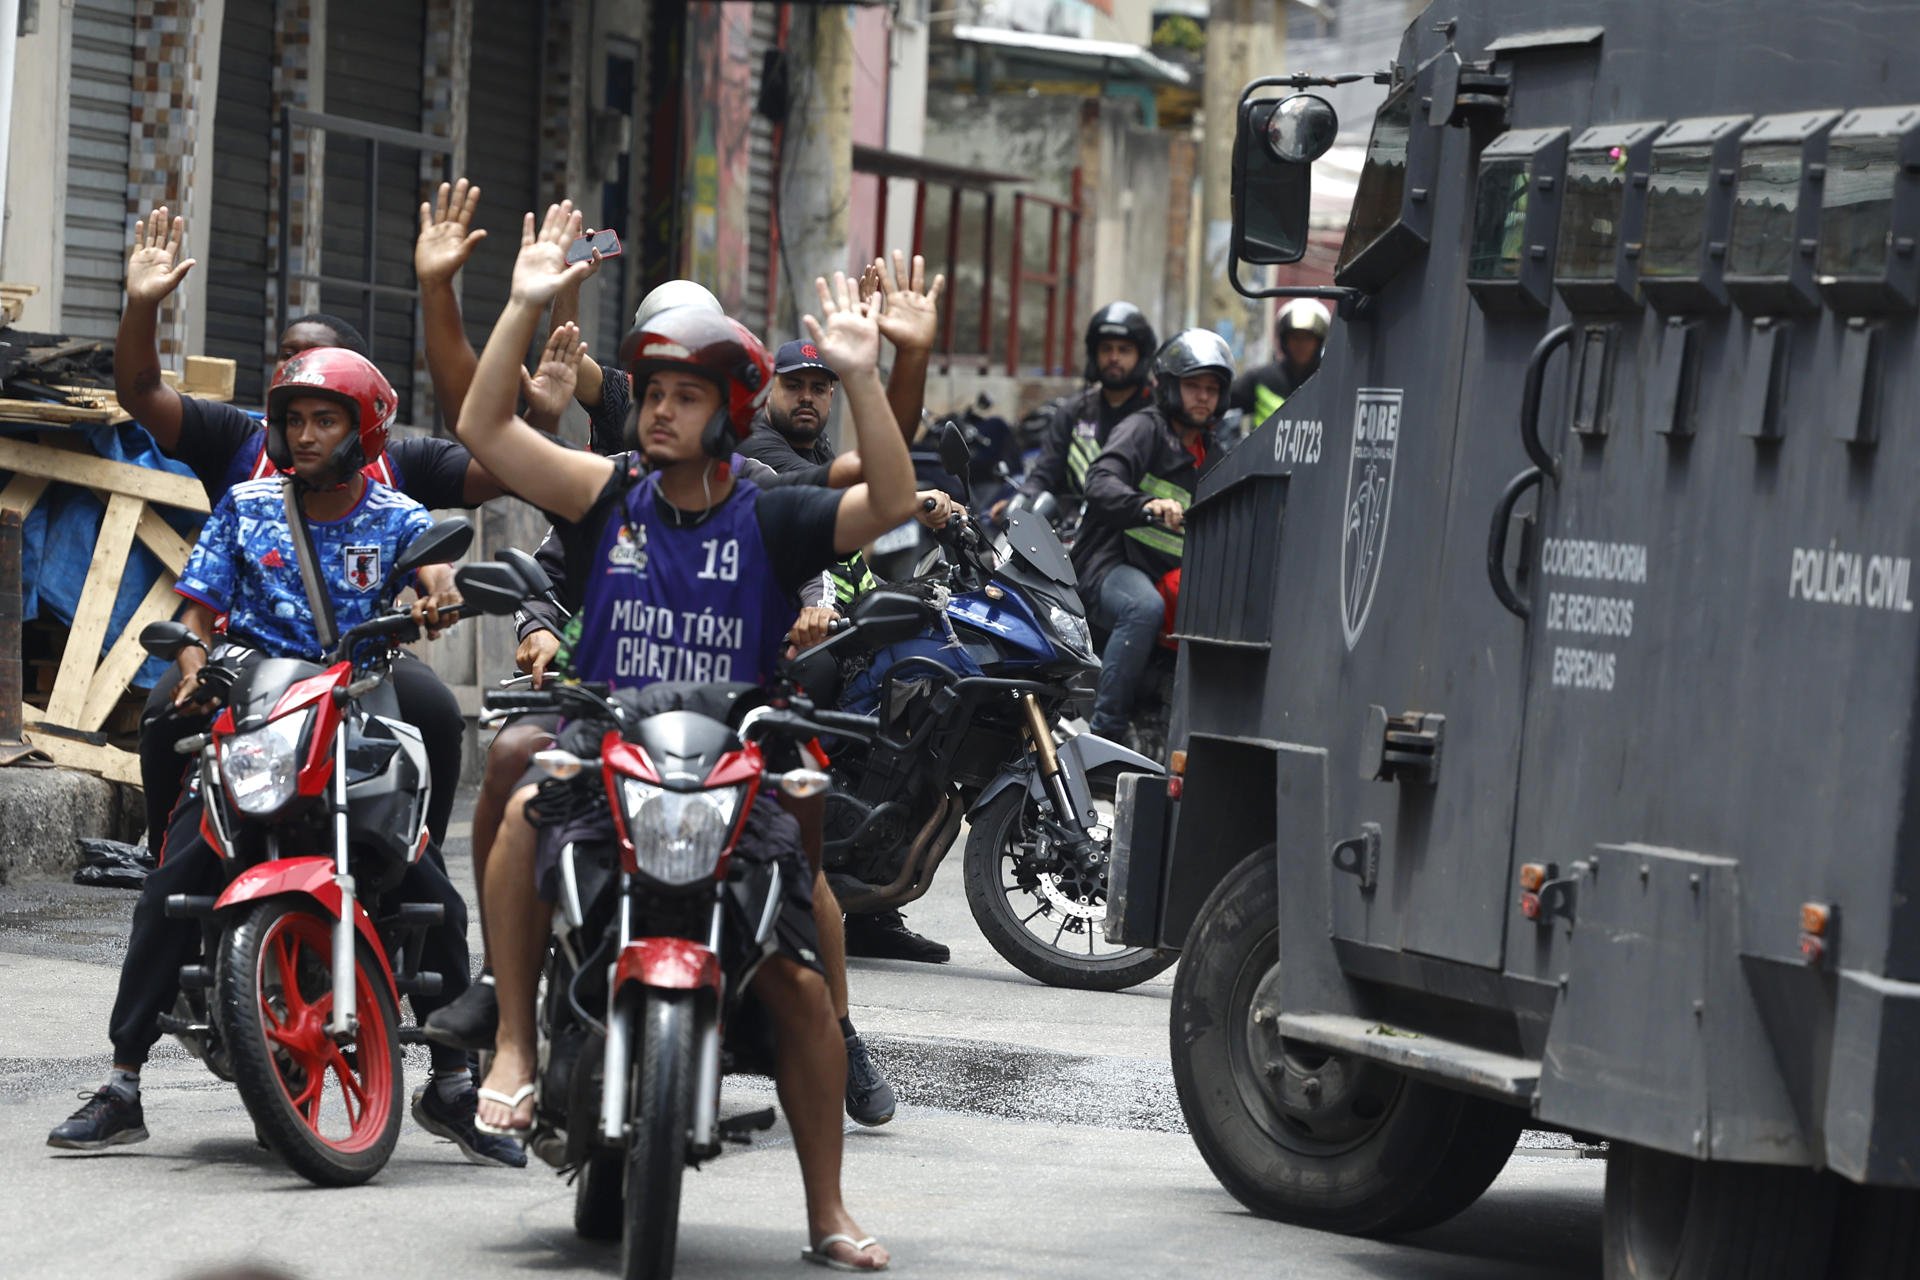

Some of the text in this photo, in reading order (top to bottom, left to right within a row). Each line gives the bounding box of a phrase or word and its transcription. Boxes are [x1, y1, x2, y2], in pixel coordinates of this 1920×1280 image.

[1274, 419, 1323, 464] 67-0723
[1357, 403, 1398, 441] CORE
[698, 538, 739, 581] 19
[1541, 537, 1647, 584] COORDENADORIA
[1789, 537, 1913, 612] POLÍCIA CIVIL
[611, 600, 743, 650] MOTO TÁXI
[1547, 592, 1634, 637] DE RECURSOS
[616, 637, 732, 683] CHATUBA
[1553, 647, 1616, 690] ESPECIAIS
